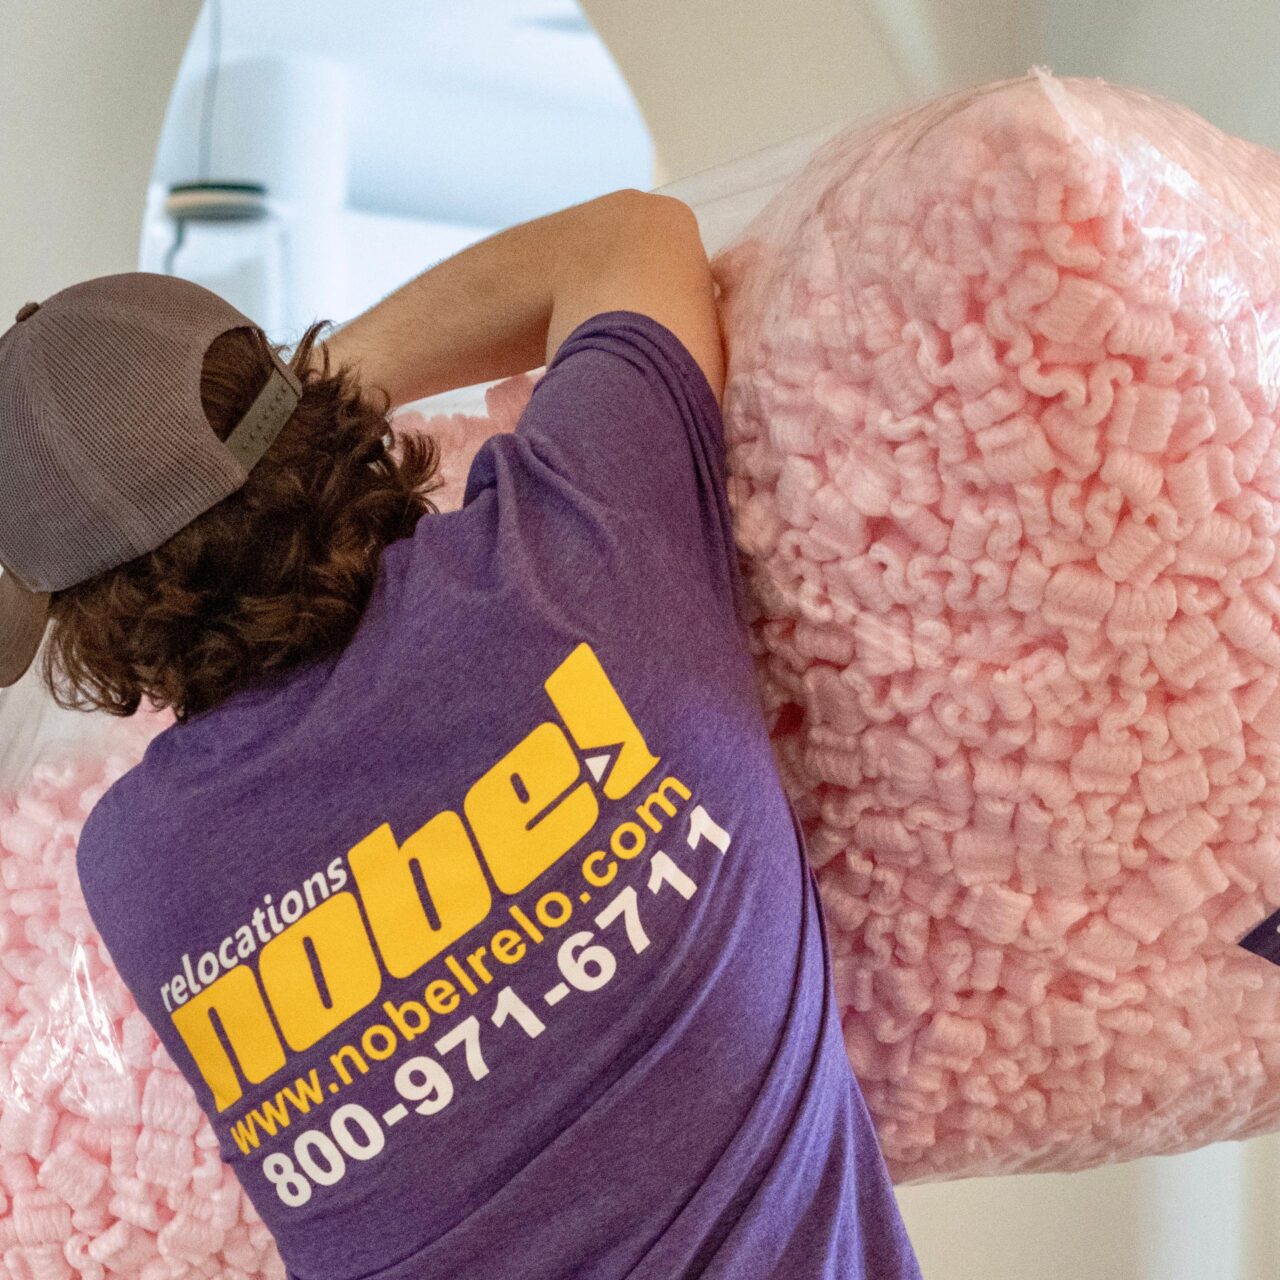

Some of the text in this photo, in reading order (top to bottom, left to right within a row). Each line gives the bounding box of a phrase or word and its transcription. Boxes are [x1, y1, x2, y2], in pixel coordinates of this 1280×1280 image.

[160, 856, 349, 1012] relocations
[171, 642, 661, 1113] nobel
[230, 776, 692, 1154] www.nobelrelo.com
[262, 805, 731, 1207] 800-971-6711
